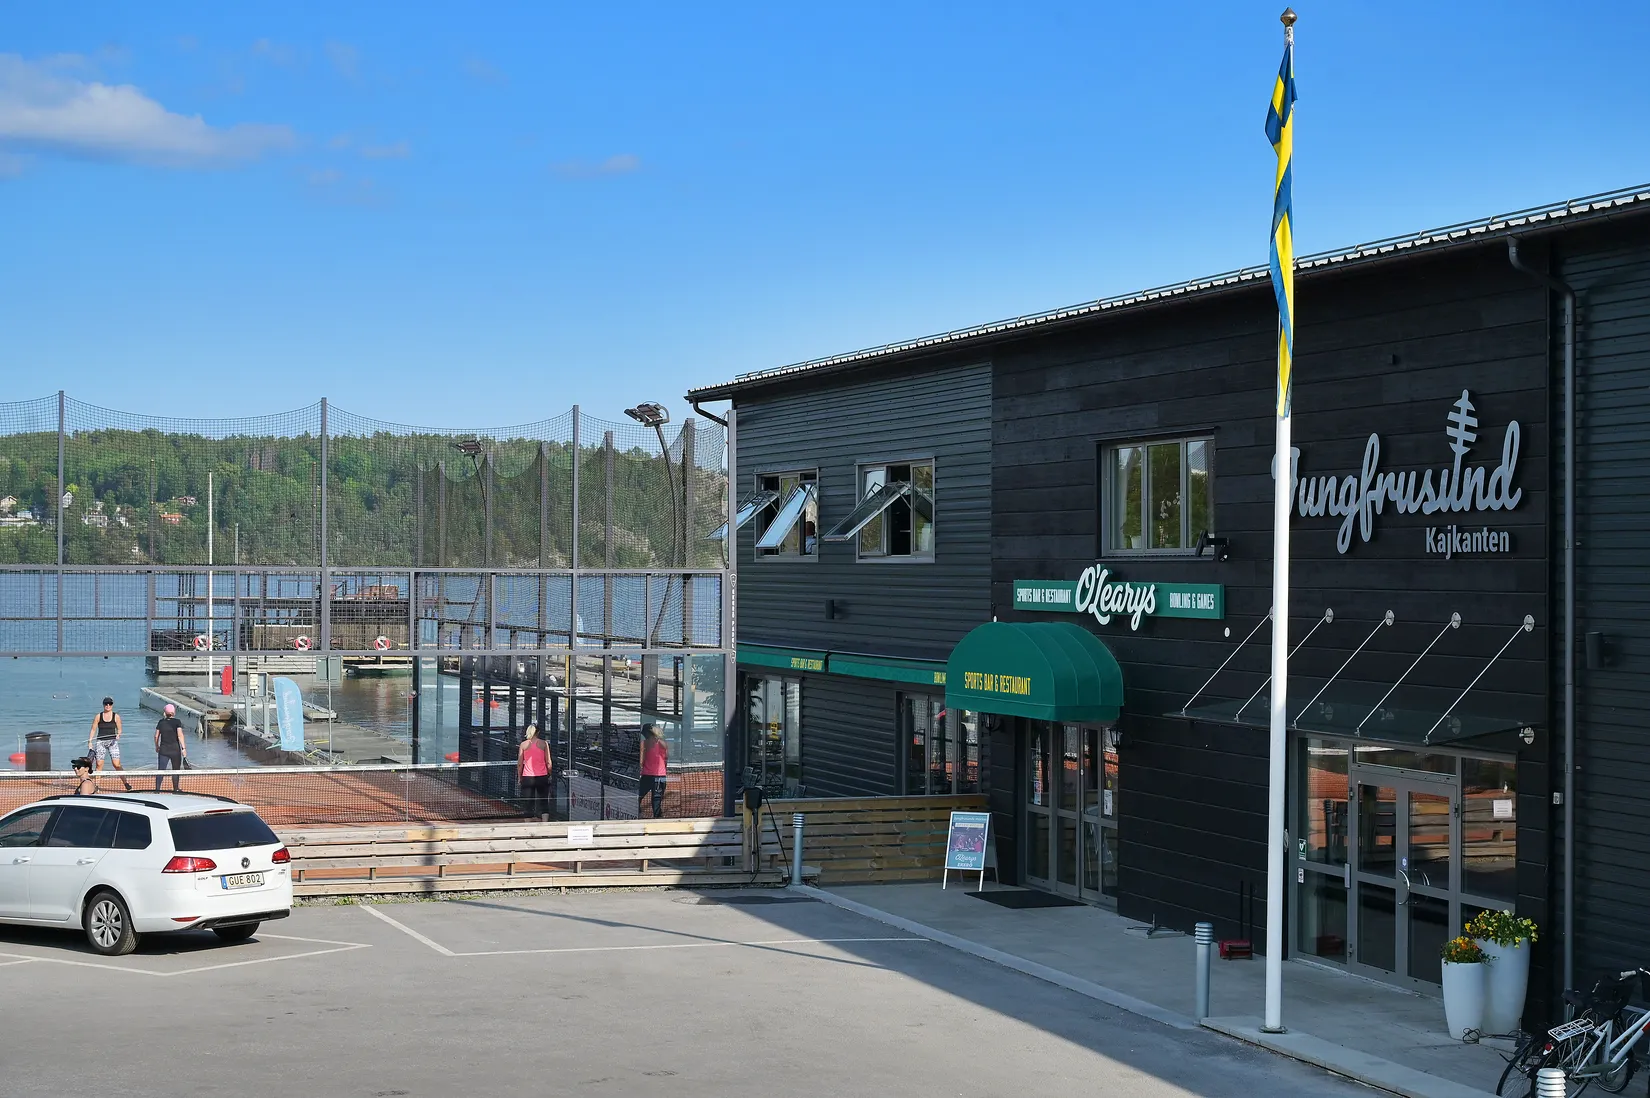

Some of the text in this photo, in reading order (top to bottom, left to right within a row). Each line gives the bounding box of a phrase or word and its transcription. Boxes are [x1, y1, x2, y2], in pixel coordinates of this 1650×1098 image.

[1425, 525, 1510, 560] Kajkanten
[1016, 588, 1072, 604] SPORTS BAR & RESTAURANT
[1075, 563, 1156, 631] O'Learys
[1169, 592, 1215, 610] BOWLING & GAMES
[964, 671, 1031, 696] SPORTS BAR & RESTAURANT
[228, 873, 261, 886] GUE 802
